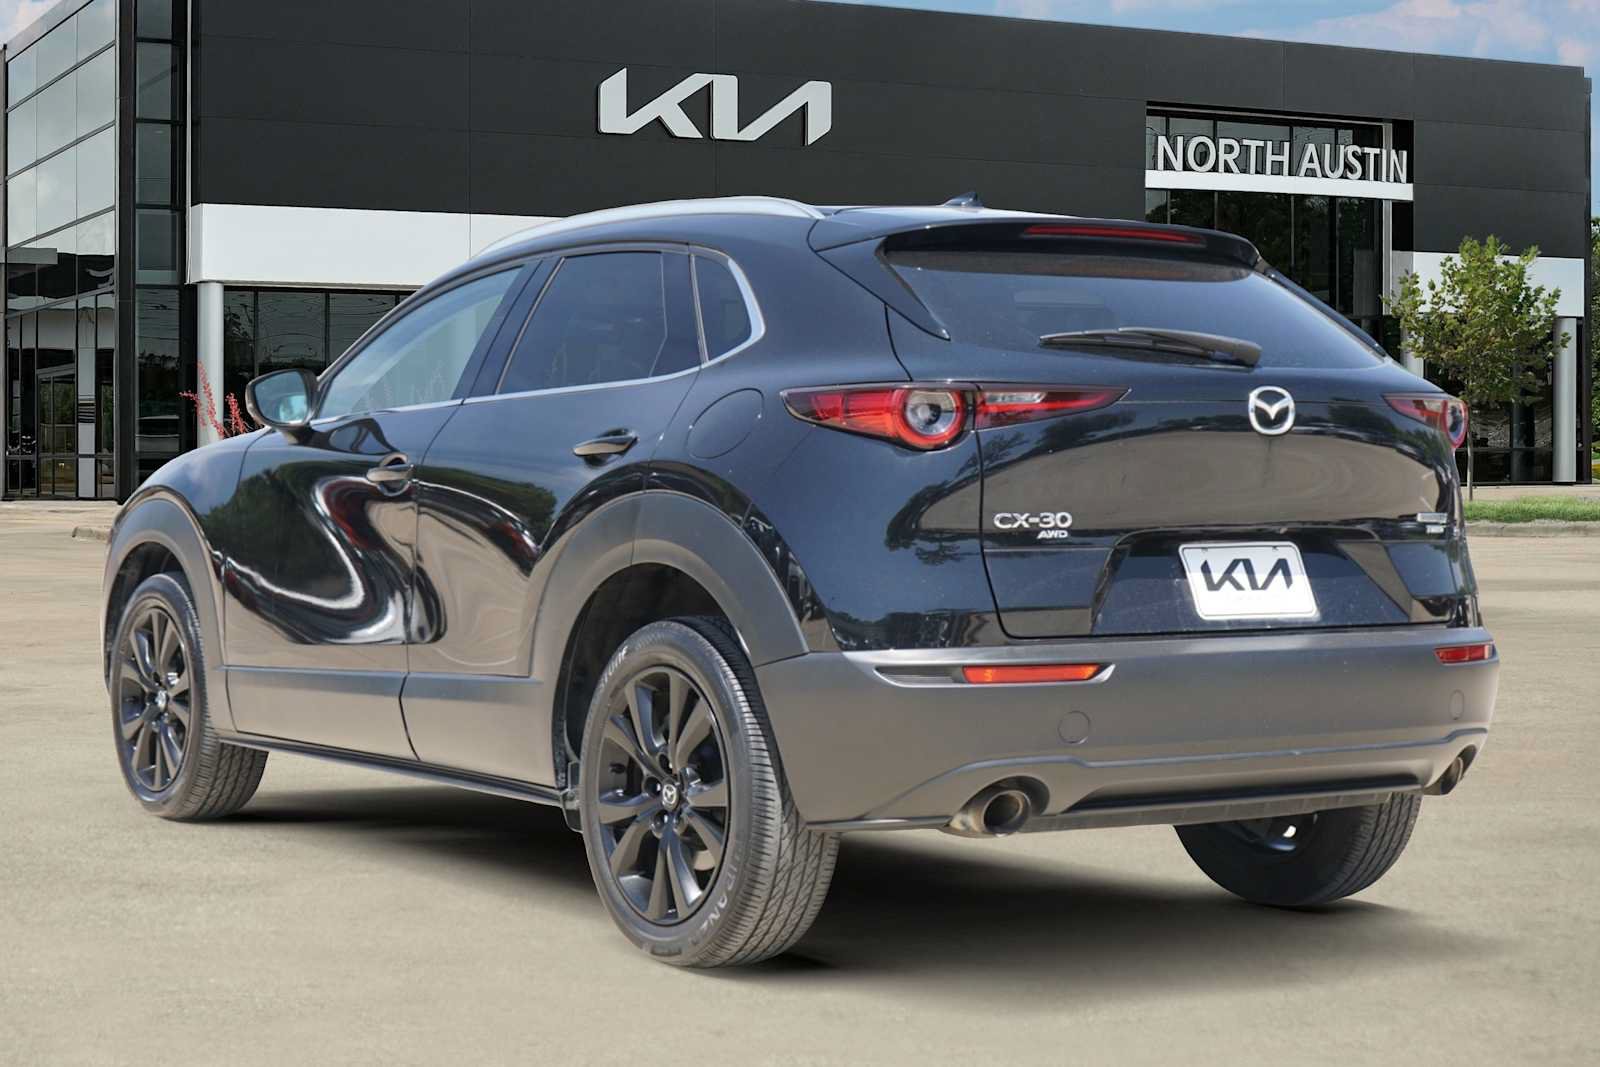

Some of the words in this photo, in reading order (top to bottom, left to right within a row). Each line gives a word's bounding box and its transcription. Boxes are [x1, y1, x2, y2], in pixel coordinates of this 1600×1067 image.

[598, 67, 832, 146] KIA
[1157, 135, 1290, 177] NORTH
[1298, 143, 1408, 184] AUSTIN
[993, 512, 1073, 529] CX-30
[1037, 529, 1069, 540] AWD
[1200, 558, 1293, 592] KIA
